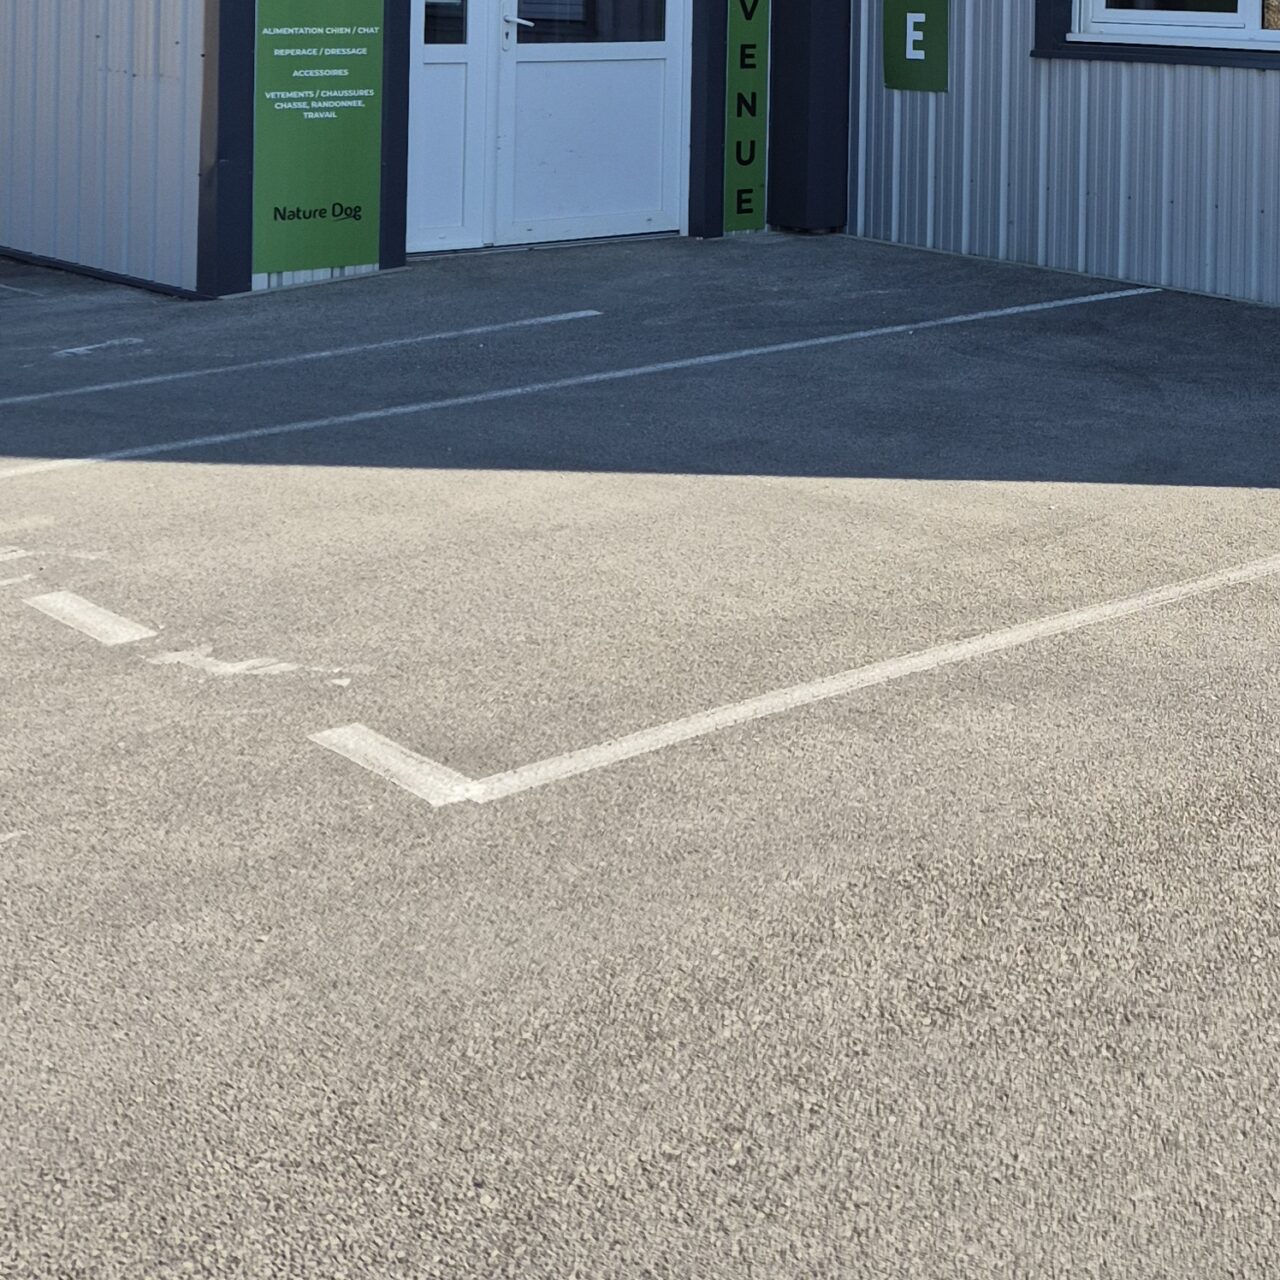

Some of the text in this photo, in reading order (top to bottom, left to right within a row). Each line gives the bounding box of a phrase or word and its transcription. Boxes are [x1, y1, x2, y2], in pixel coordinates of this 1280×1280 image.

[262, 27, 324, 35] ALIMENTATION
[274, 48, 318, 56] REPERAGE
[292, 69, 349, 77] ACCESSOIRES
[265, 91, 315, 99] VETEMENTS
[320, 89, 375, 97] CHAUSSURES
[303, 111, 338, 119] TRAVAIL
[273, 202, 362, 221] Nature Dog
